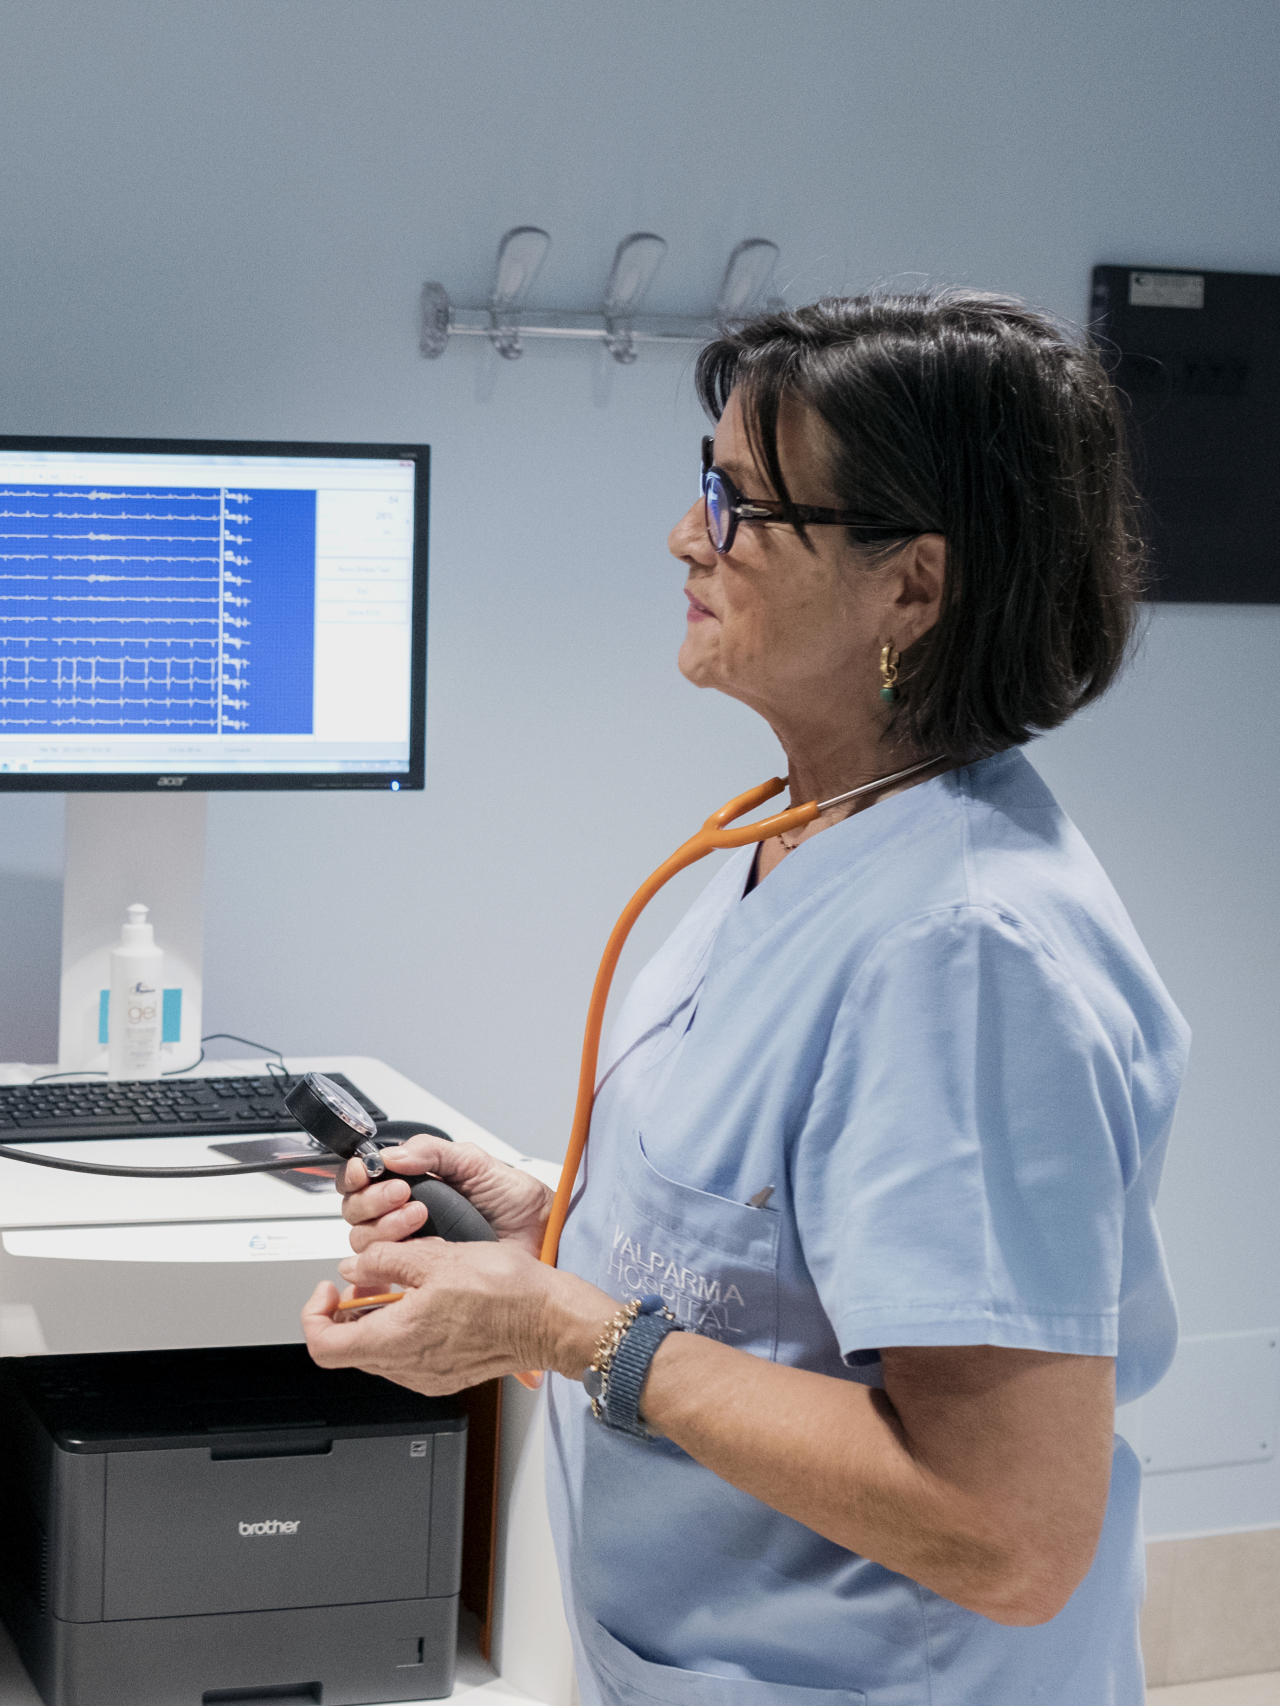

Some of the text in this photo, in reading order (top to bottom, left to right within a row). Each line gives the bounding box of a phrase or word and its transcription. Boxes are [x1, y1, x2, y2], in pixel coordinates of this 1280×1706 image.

[157, 776, 188, 787] acer
[128, 1001, 157, 1025] gel
[612, 1224, 746, 1308] VALPARMA
[606, 1251, 747, 1334] HOSPITAL
[238, 1519, 301, 1536] brother
